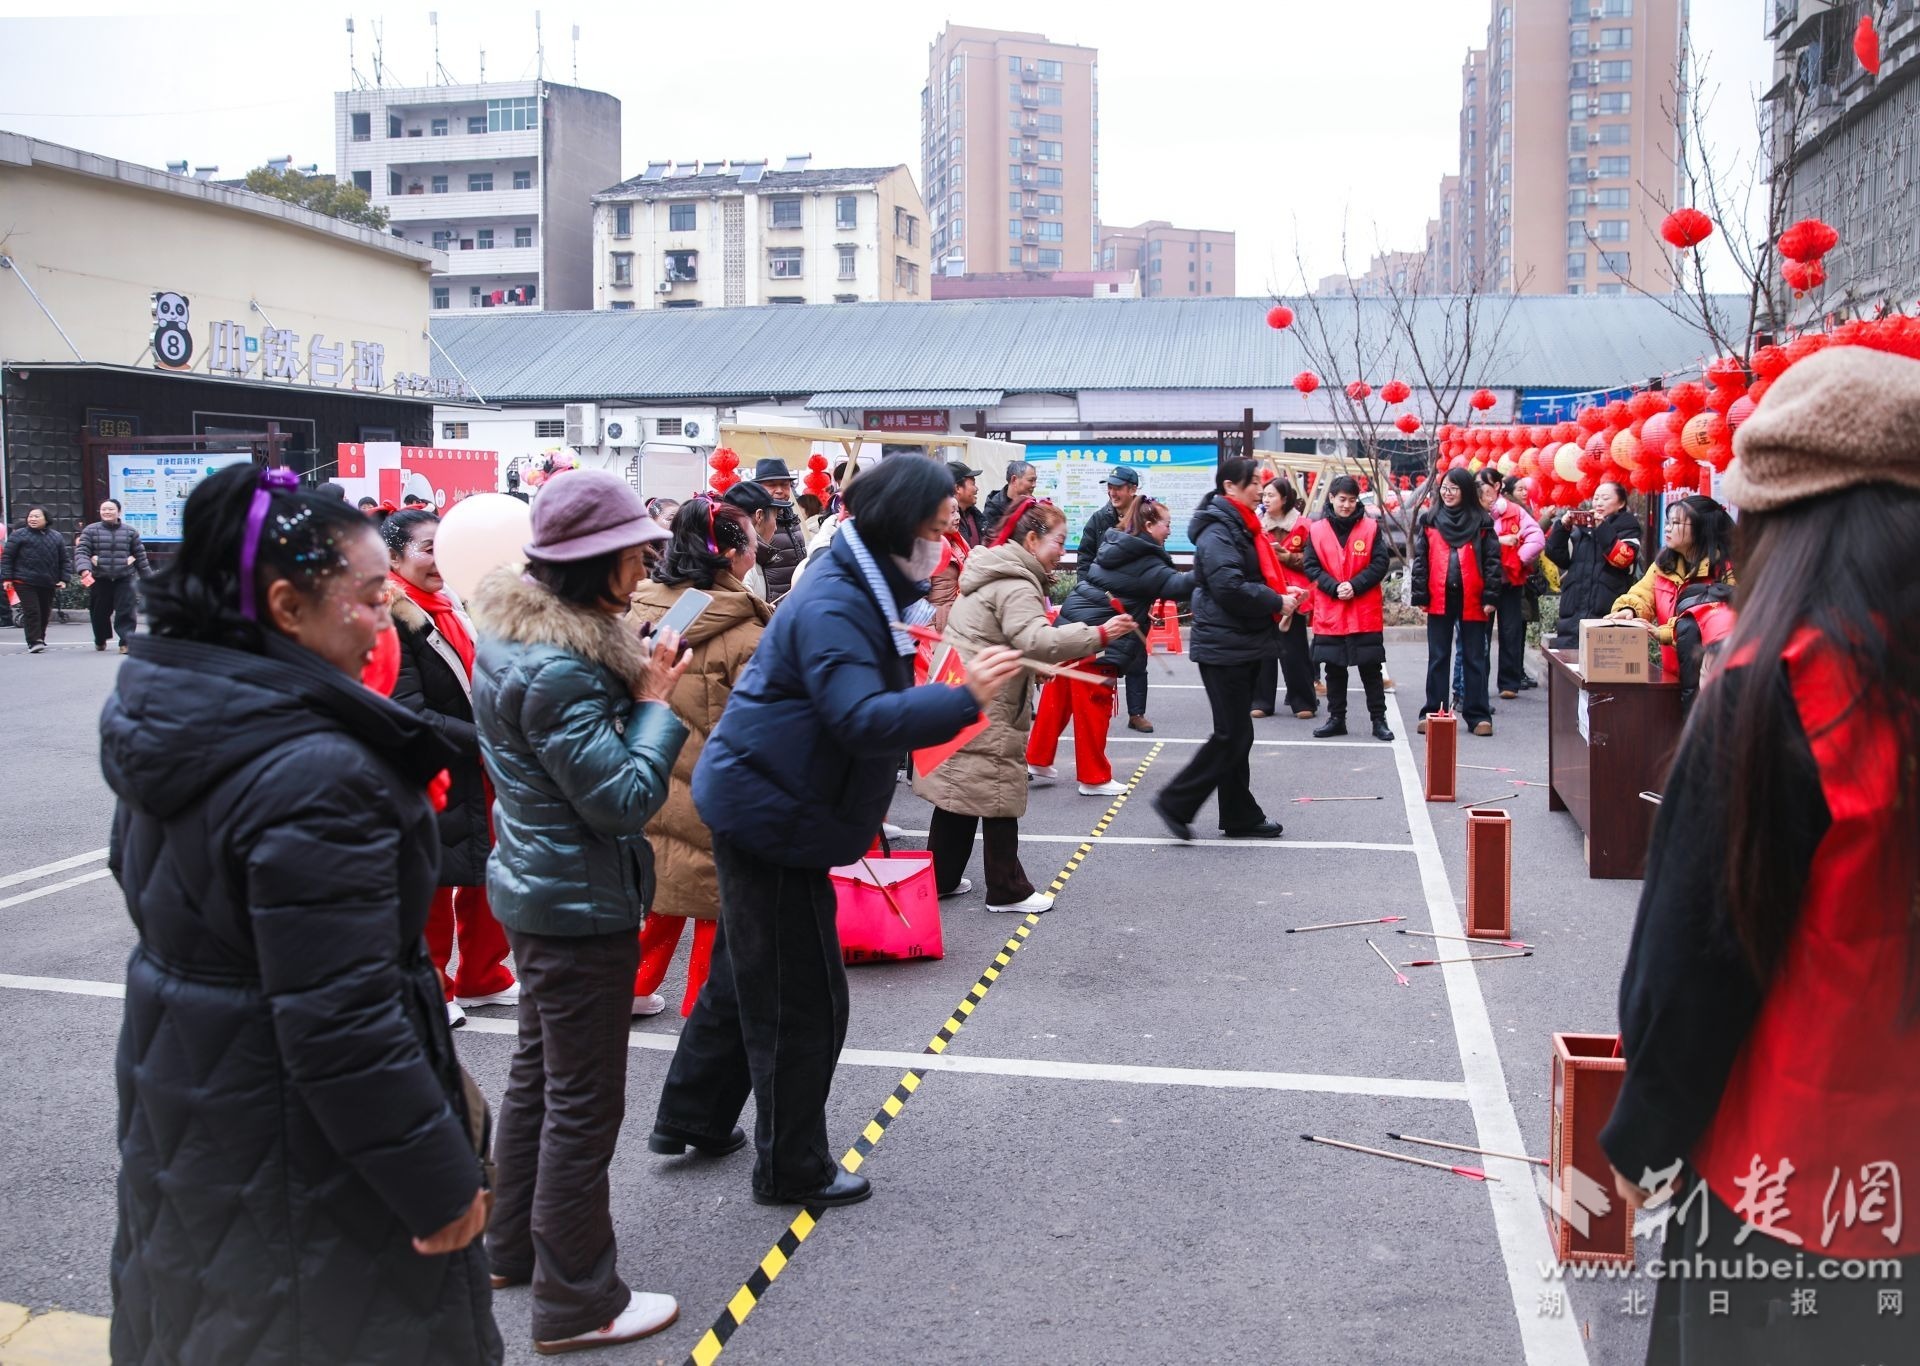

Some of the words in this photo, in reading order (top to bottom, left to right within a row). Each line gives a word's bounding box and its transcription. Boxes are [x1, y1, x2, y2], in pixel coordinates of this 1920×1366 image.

[167, 335, 180, 356] 8
[207, 319, 385, 388] 小铁台球
[882, 414, 945, 427] 鲜果二当家
